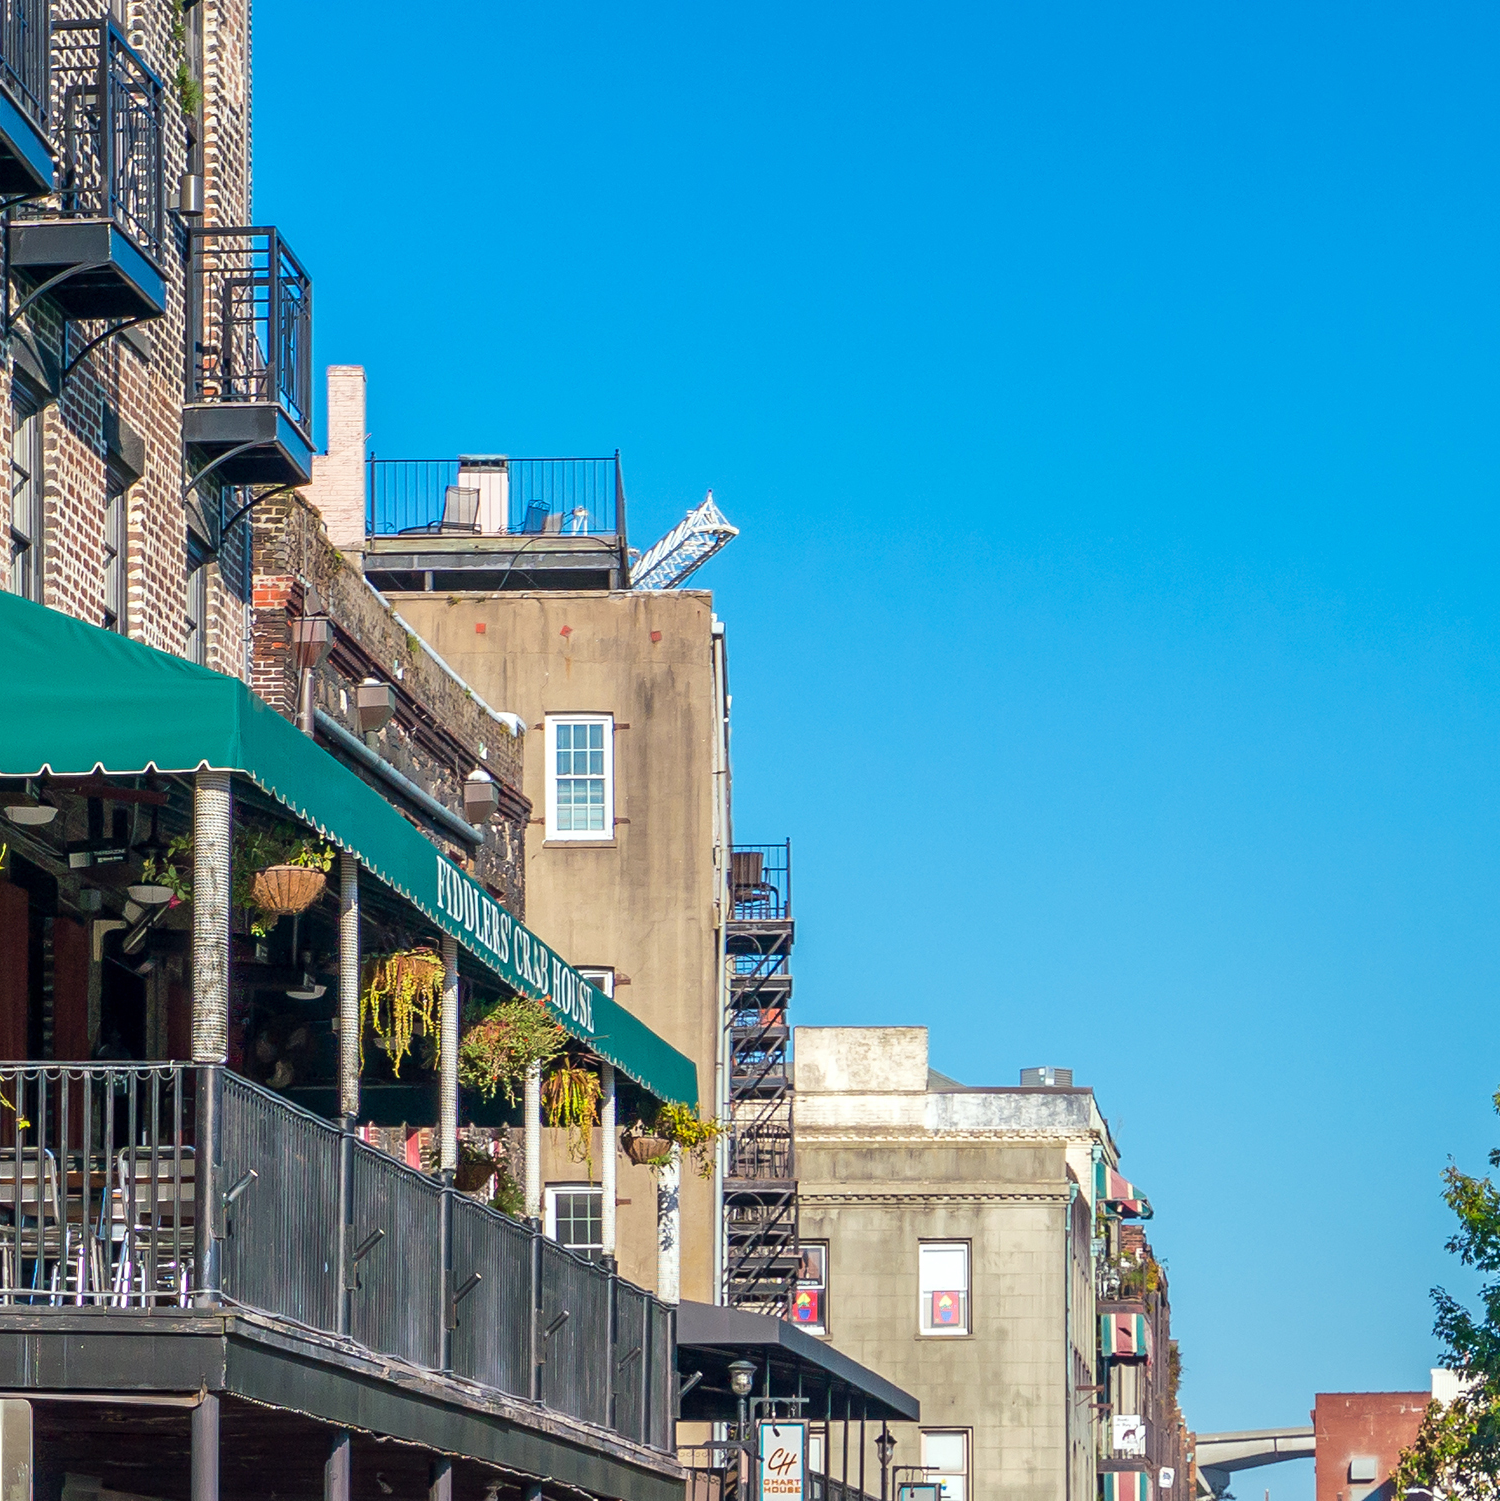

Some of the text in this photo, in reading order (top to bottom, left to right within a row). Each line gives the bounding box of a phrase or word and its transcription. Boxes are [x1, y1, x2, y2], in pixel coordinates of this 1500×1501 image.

[436, 854, 595, 1034] FIDDLERS' CRAB HOUSE
[763, 1478, 802, 1486] CHART
[763, 1486, 802, 1494] HOUSE
